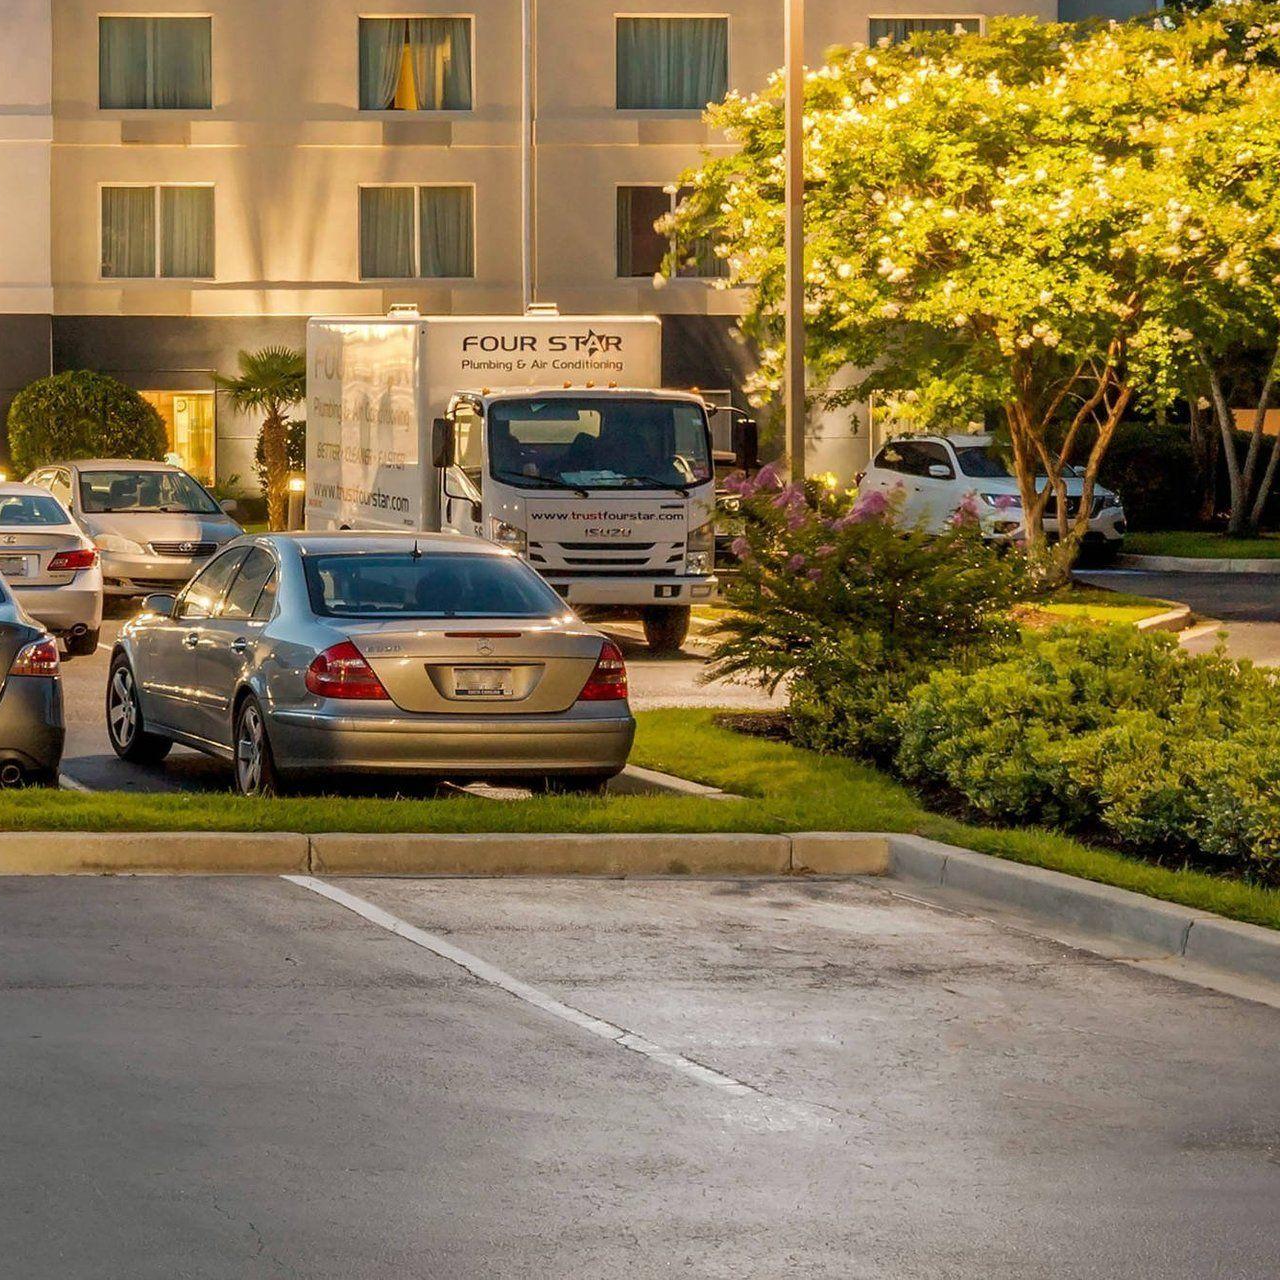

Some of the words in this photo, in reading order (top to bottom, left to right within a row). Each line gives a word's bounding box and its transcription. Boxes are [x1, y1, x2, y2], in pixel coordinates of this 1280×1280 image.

[462, 335, 538, 352] FOUR
[547, 329, 623, 357] STAR
[461, 359, 513, 372] Plumbing
[516, 358, 527, 370] &
[530, 358, 548, 370] Air
[552, 358, 624, 372] Conditioning
[531, 511, 685, 521] www.trustfourstar.com
[585, 528, 632, 538] ISUZU
